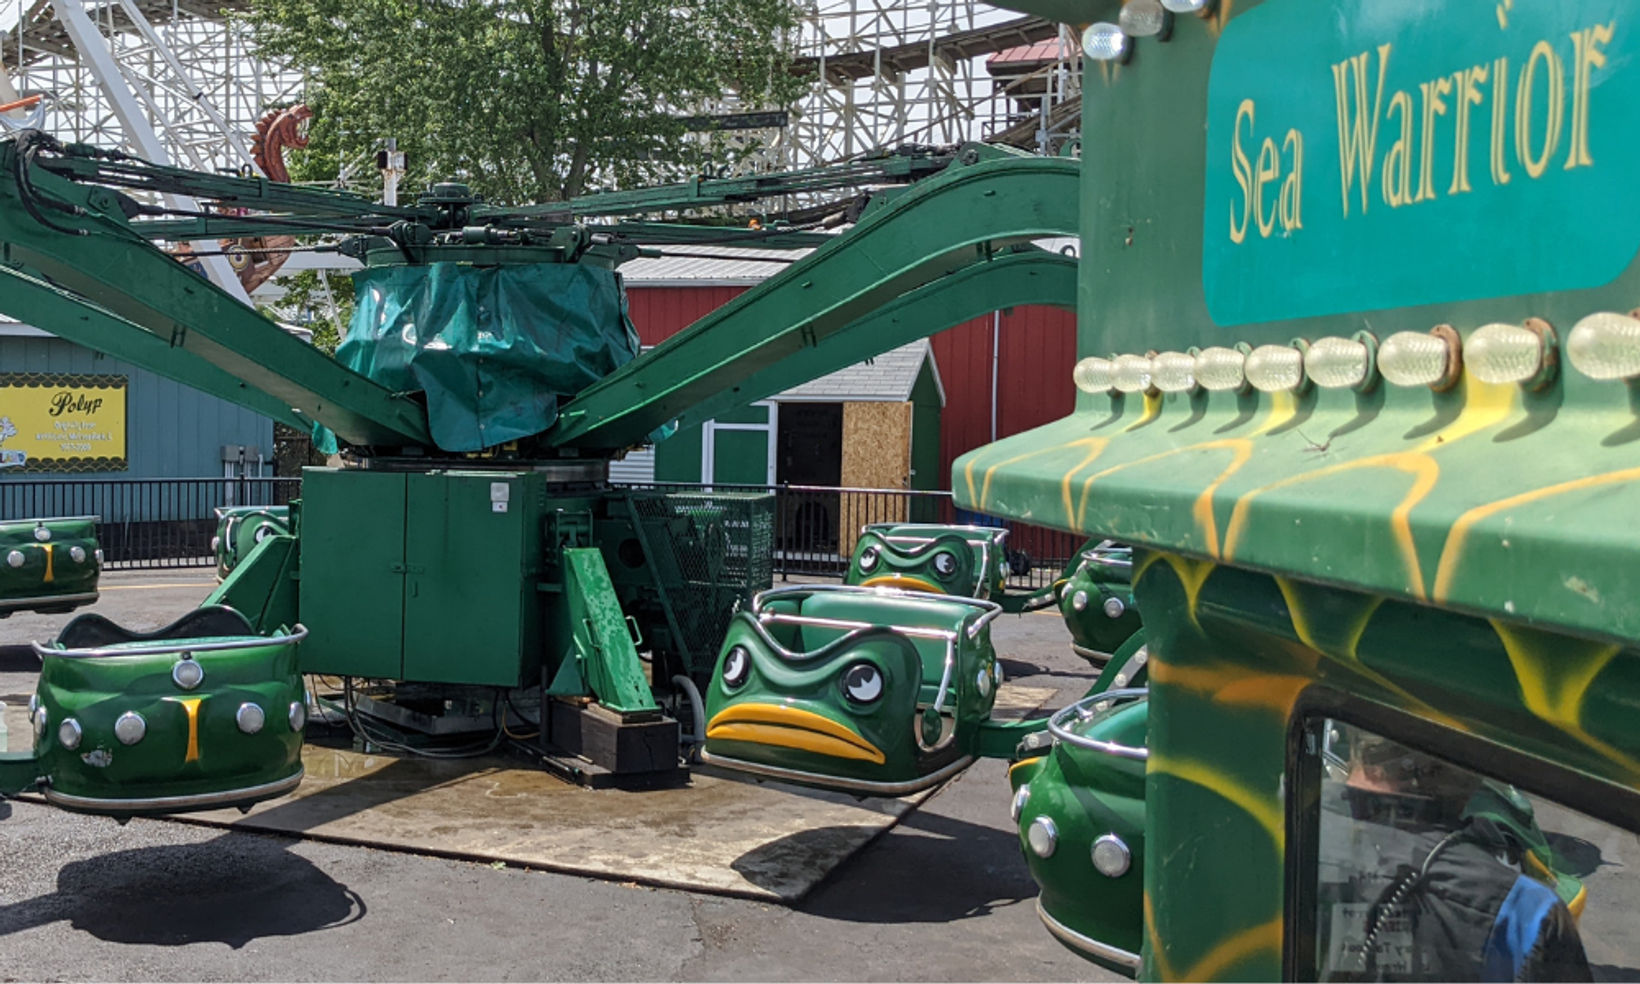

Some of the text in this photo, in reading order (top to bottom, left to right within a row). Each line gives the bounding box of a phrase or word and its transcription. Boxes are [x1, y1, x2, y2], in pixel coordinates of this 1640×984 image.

[1229, 0, 1615, 245] Sea Warrior
[48, 391, 103, 417] Polyp
